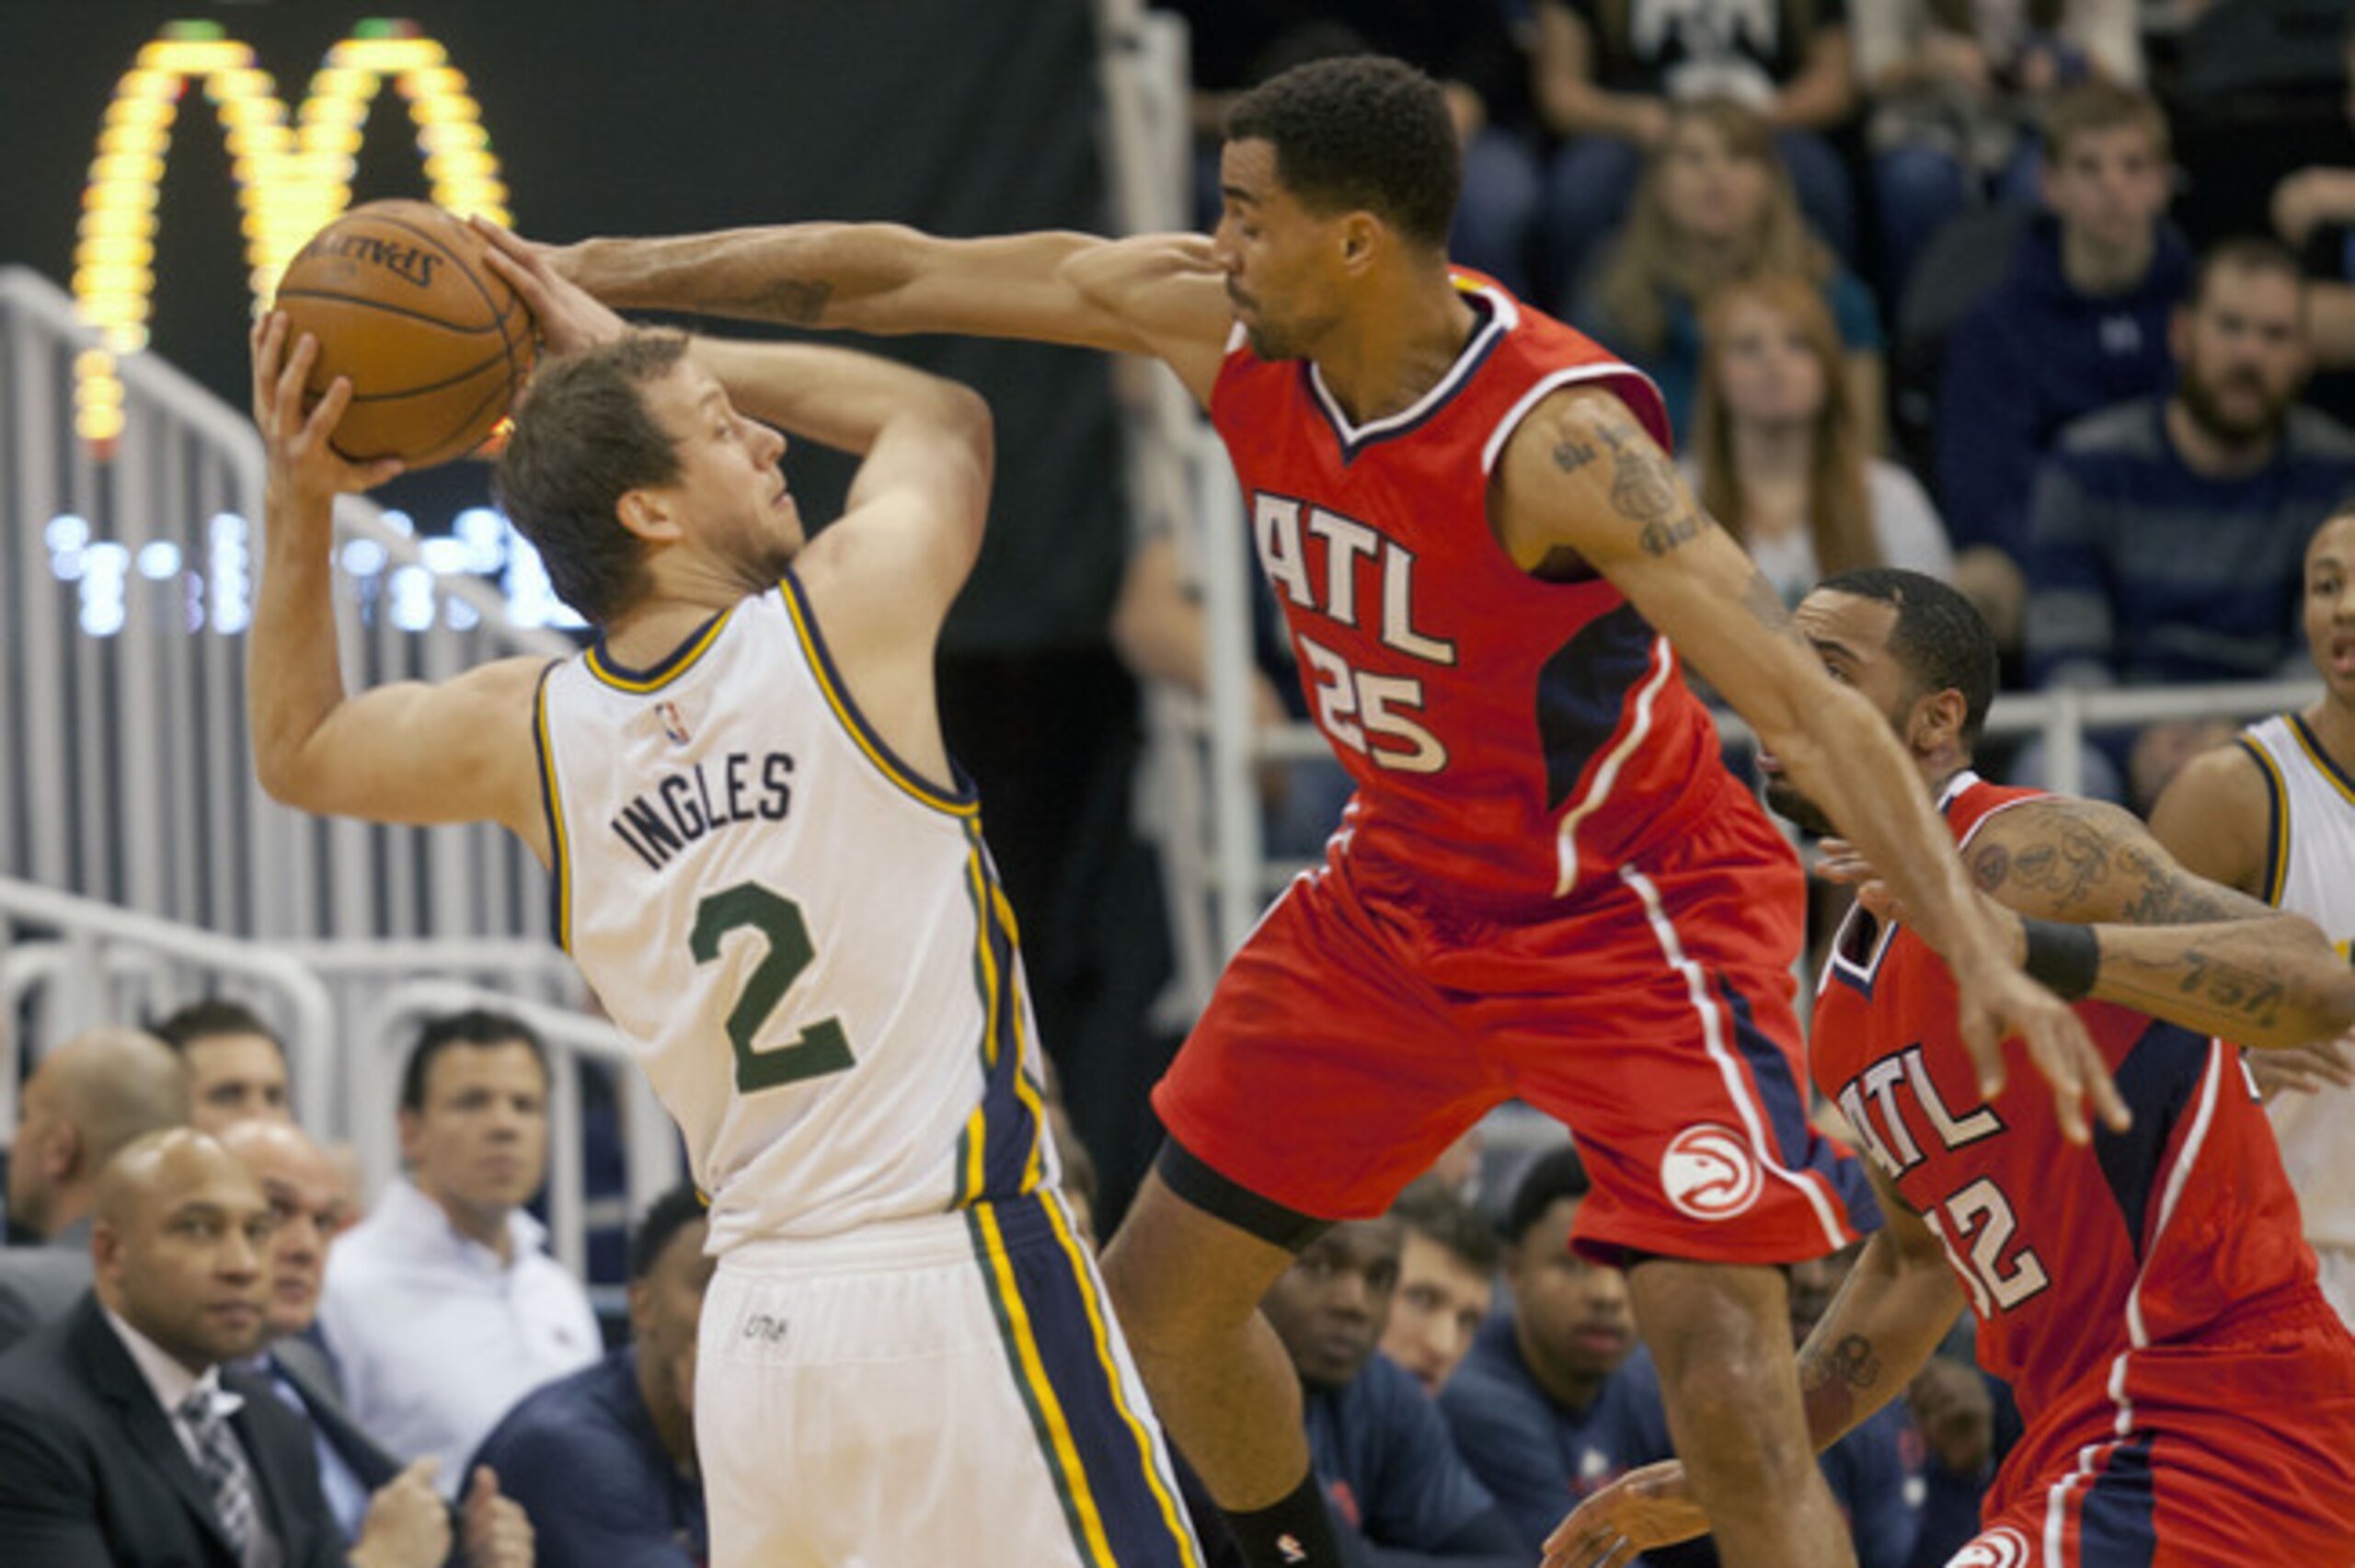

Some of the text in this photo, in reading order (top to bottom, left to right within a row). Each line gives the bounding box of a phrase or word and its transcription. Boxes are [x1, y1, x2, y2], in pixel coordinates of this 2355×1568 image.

[1252, 487, 1457, 665] ATL
[1297, 632, 1449, 773] 25
[611, 752, 795, 872] INGLES
[689, 880, 856, 1094] 2
[1837, 1042, 2007, 1182] ATL
